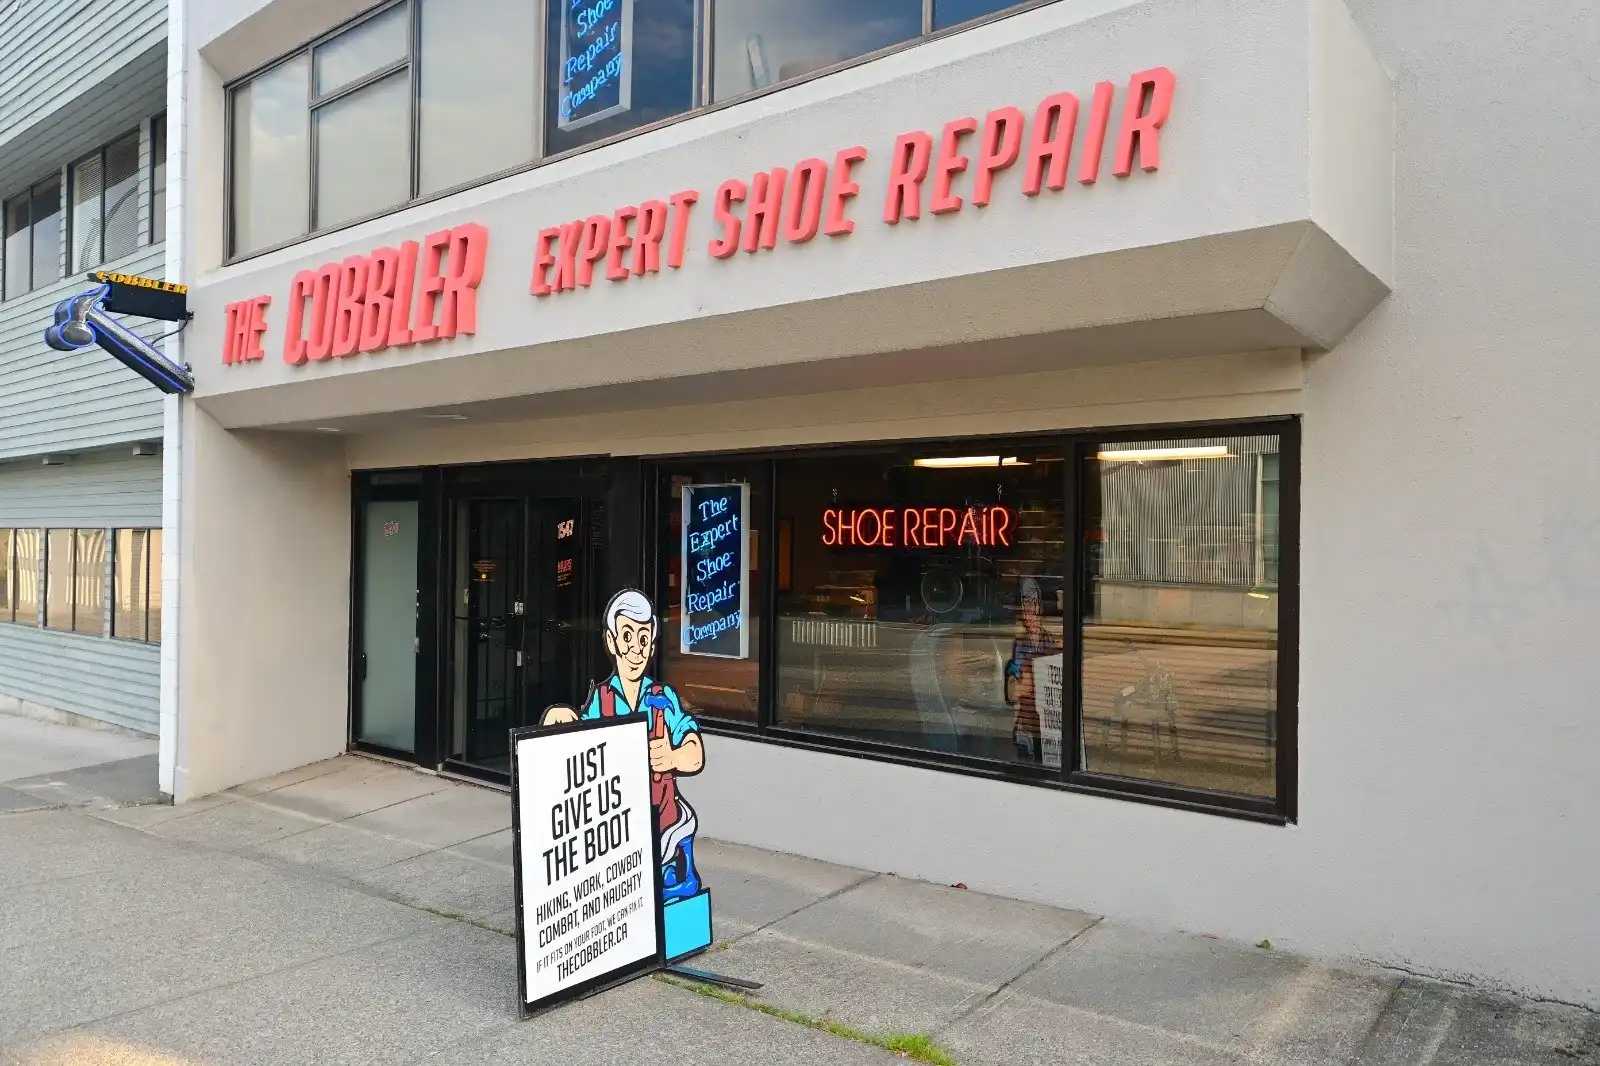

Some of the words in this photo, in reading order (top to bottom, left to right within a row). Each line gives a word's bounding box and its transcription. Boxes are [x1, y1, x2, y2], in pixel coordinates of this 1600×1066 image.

[563, 21, 618, 85] Repair
[560, 52, 622, 117] Company
[222, 295, 271, 365] THE
[283, 222, 488, 365] COBBLER
[529, 189, 698, 297] EXPERT
[708, 145, 867, 259] SHOE
[883, 66, 1176, 225] REPAIR
[96, 271, 188, 294] COBBLER
[689, 514, 738, 553] Expert
[698, 496, 729, 522] The
[822, 508, 894, 547] SHOE
[696, 551, 734, 582] Shoe
[682, 609, 742, 645] Company
[687, 580, 736, 615] Repair
[563, 741, 607, 795] JUST
[551, 788, 593, 841] GIVE
[597, 775, 622, 817] US
[542, 836, 579, 886] THE
[584, 808, 631, 865] BOOT
[536, 891, 572, 925] HIKING,
[573, 872, 605, 903] WORK,
[605, 848, 643, 884] COWBOY
[539, 909, 580, 949] COMBAT,
[582, 896, 601, 923] AND
[603, 871, 643, 910] NAUGHTY
[536, 960, 543, 974] IF
[543, 954, 550, 968] IT
[550, 947, 563, 965] FITS
[564, 940, 573, 955] ON
[574, 930, 590, 948] YOUR
[607, 914, 616, 928] WE
[617, 906, 628, 921] CAN
[629, 901, 638, 915] FIX
[638, 896, 644, 909] IT
[556, 922, 628, 982] THECOBBLER.CA
